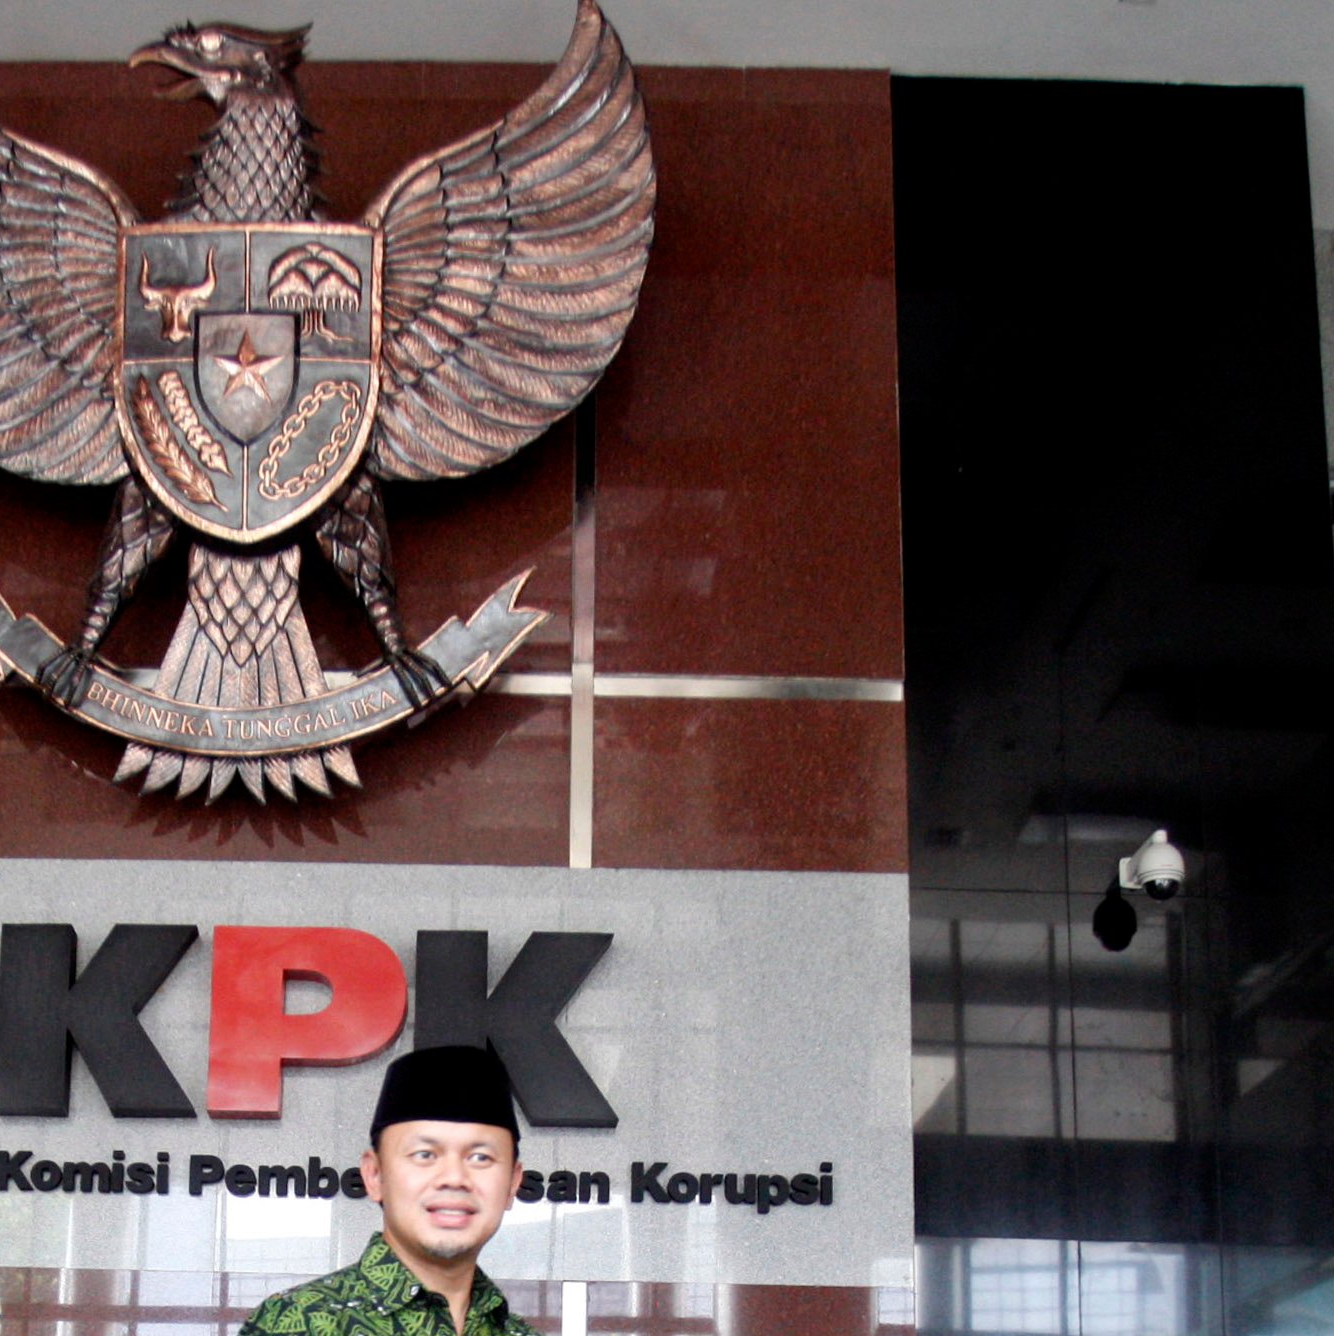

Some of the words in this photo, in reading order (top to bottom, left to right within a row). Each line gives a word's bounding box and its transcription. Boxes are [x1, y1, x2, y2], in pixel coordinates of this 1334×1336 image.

[87, 681, 213, 737] BHINNEKA
[223, 707, 346, 740] TUNGGAL
[349, 690, 398, 720] IKA
[630, 1161, 834, 1215] Korupsi
